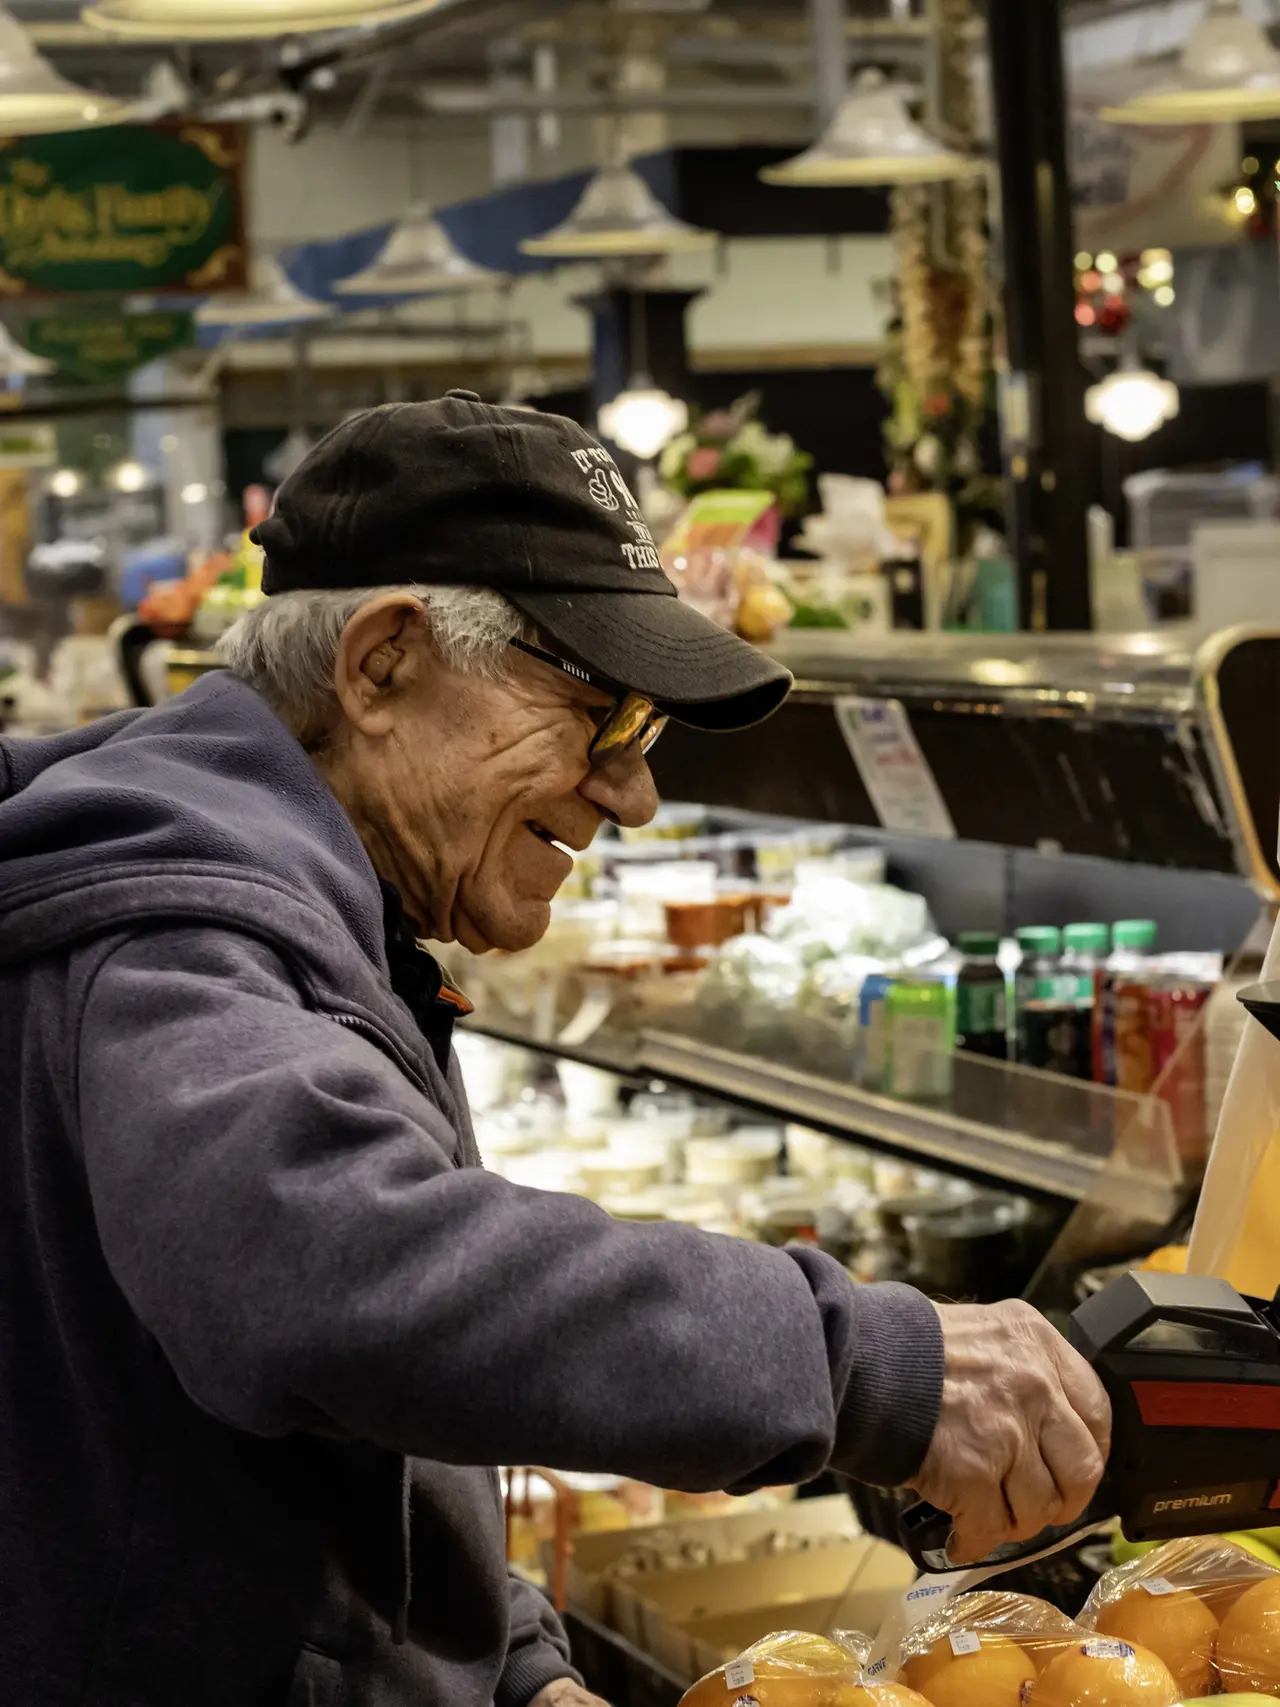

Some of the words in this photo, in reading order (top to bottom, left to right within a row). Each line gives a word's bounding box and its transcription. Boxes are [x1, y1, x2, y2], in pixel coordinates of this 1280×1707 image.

[570, 449, 593, 474] IT
[620, 543, 660, 570] THIS
[1152, 1493, 1231, 1513] premium
